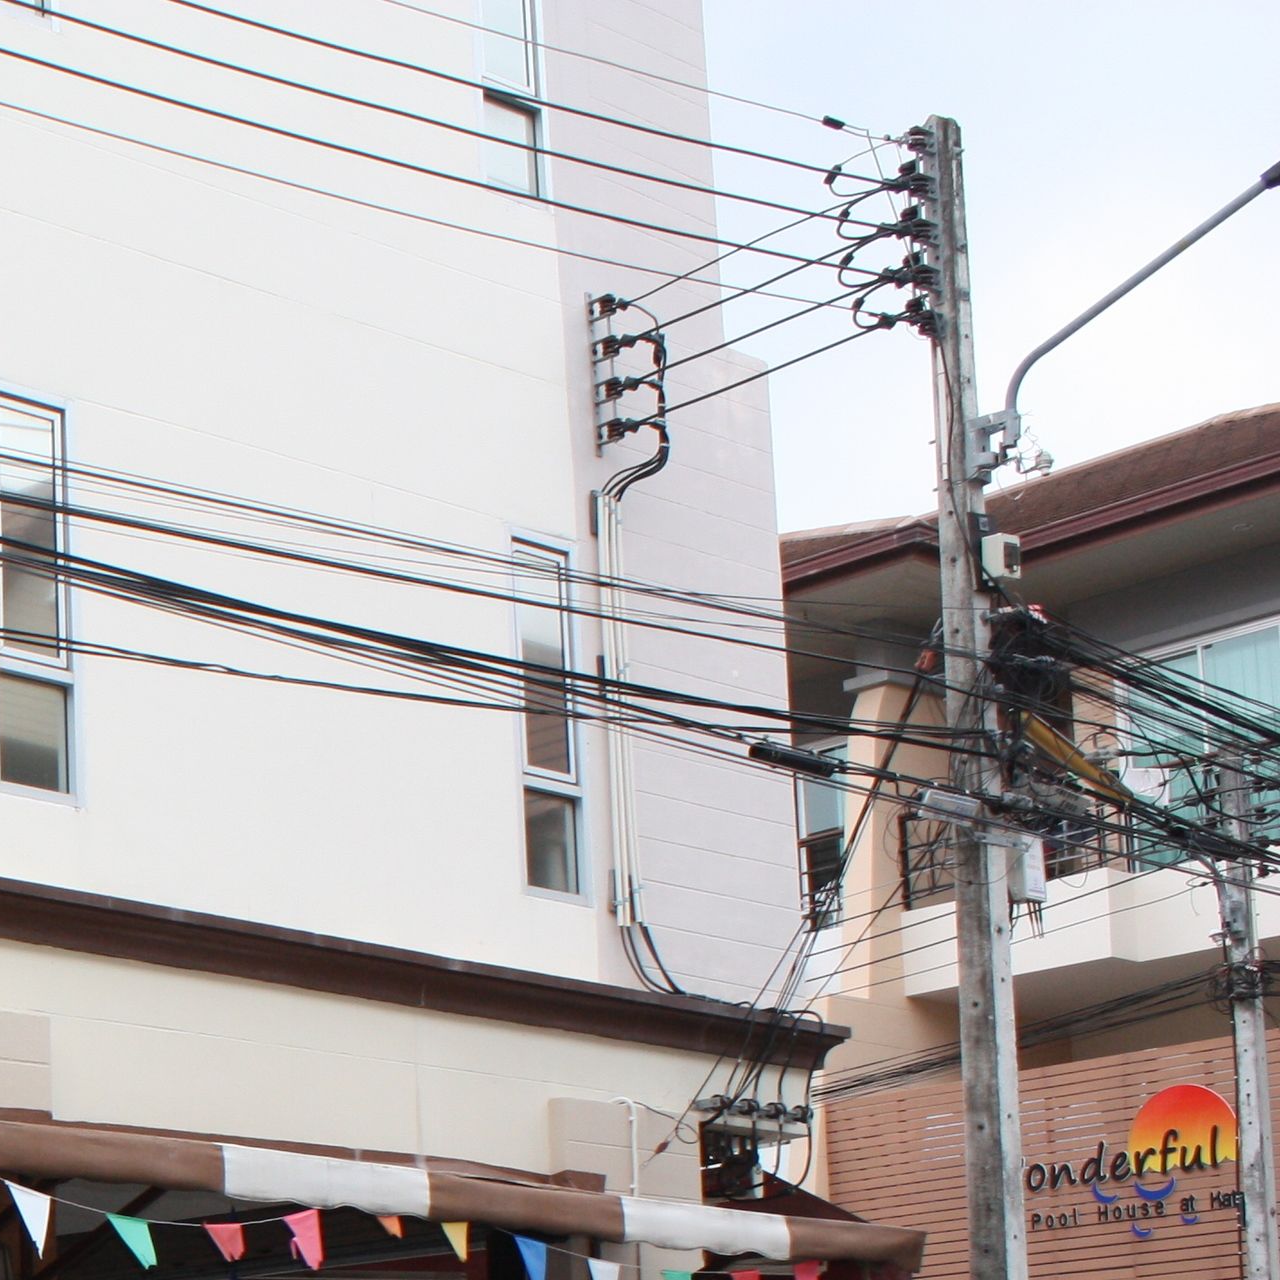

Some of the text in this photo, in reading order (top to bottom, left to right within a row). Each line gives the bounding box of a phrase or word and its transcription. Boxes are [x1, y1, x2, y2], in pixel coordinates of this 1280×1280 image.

[1022, 1124, 1220, 1193] onderful
[1031, 1207, 1080, 1231] Pool
[1097, 1200, 1167, 1222] House
[1179, 1193, 1196, 1213] at
